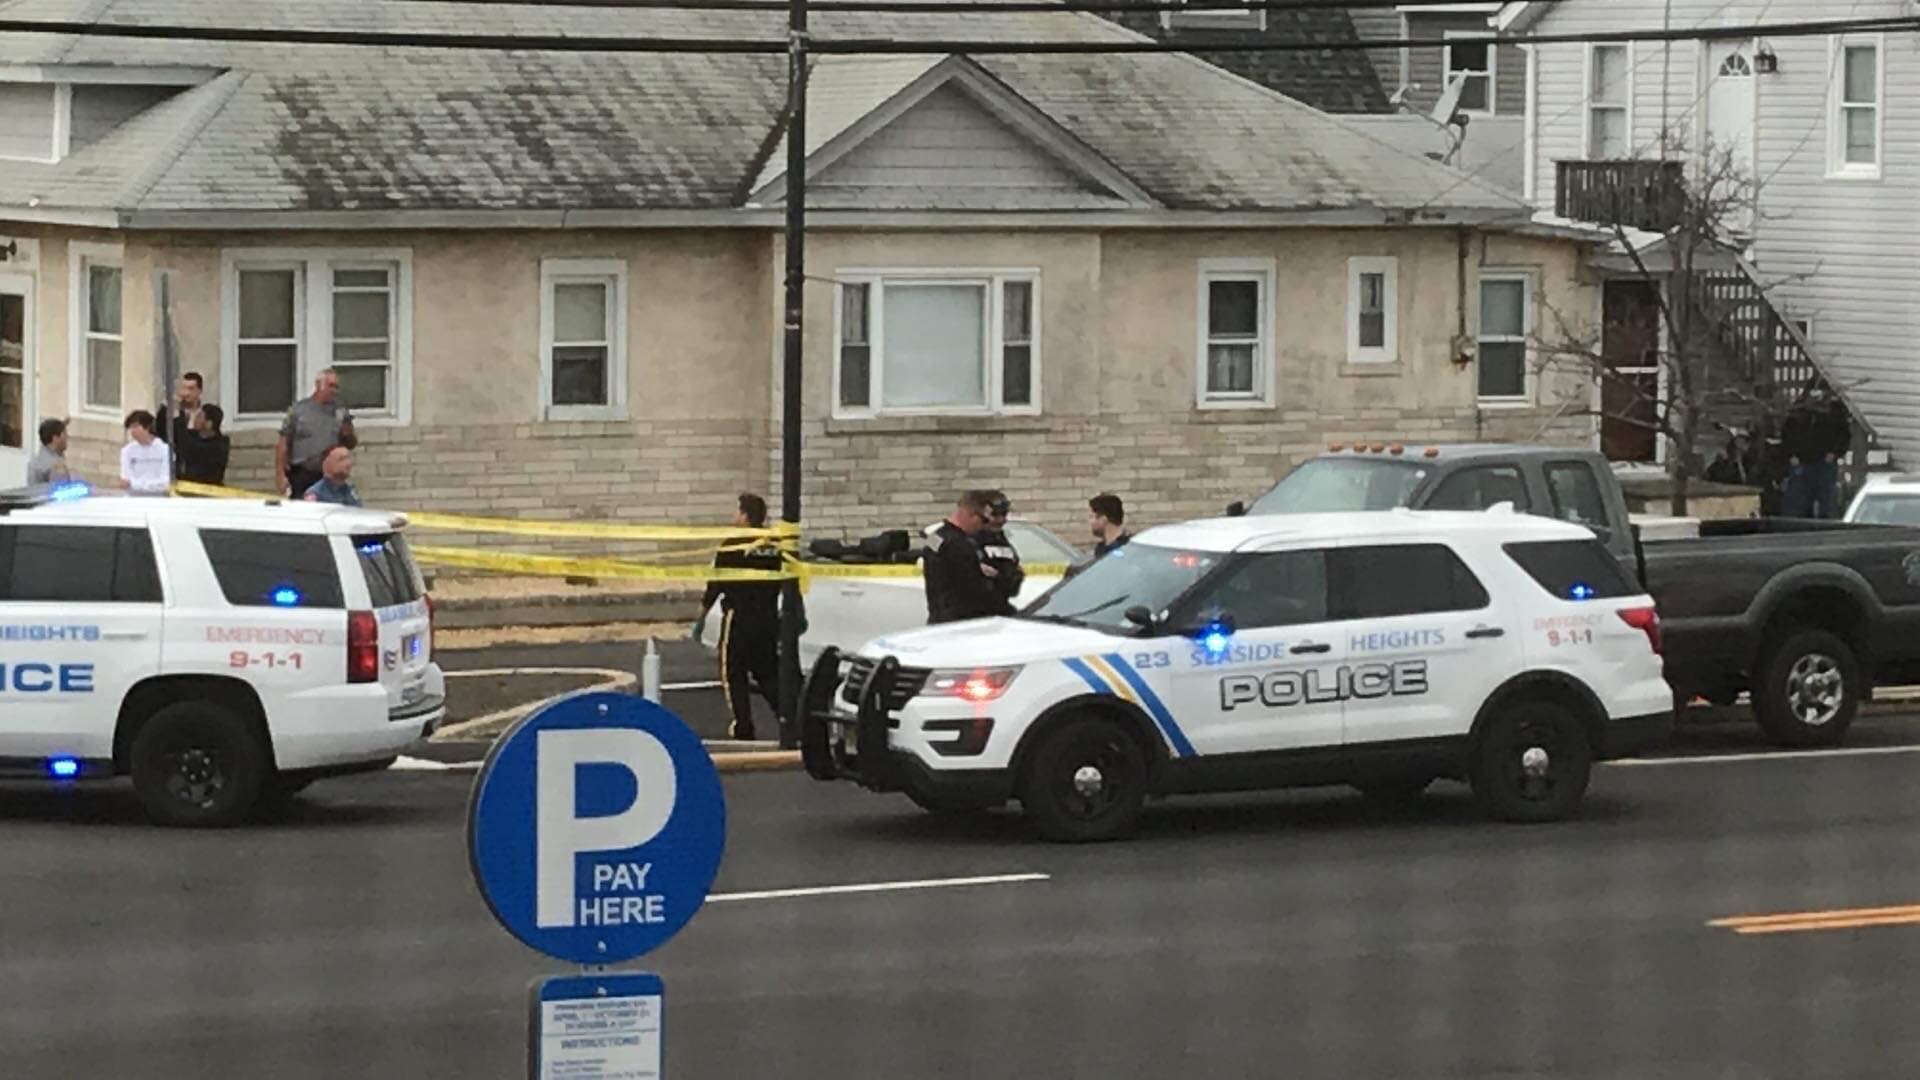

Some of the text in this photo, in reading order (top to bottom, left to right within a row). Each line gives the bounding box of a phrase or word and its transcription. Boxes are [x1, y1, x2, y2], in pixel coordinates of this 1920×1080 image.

[0, 625, 99, 641] EIGHTS
[206, 625, 325, 643] EMERGENCY
[1351, 627, 1445, 651] HEIGHTS
[229, 651, 302, 669] 9-1-1
[1135, 652, 1170, 668] 23
[1220, 660, 1428, 710] POLICE
[537, 727, 677, 928] P
[593, 863, 652, 891] PAY
[580, 895, 665, 926] HERE
